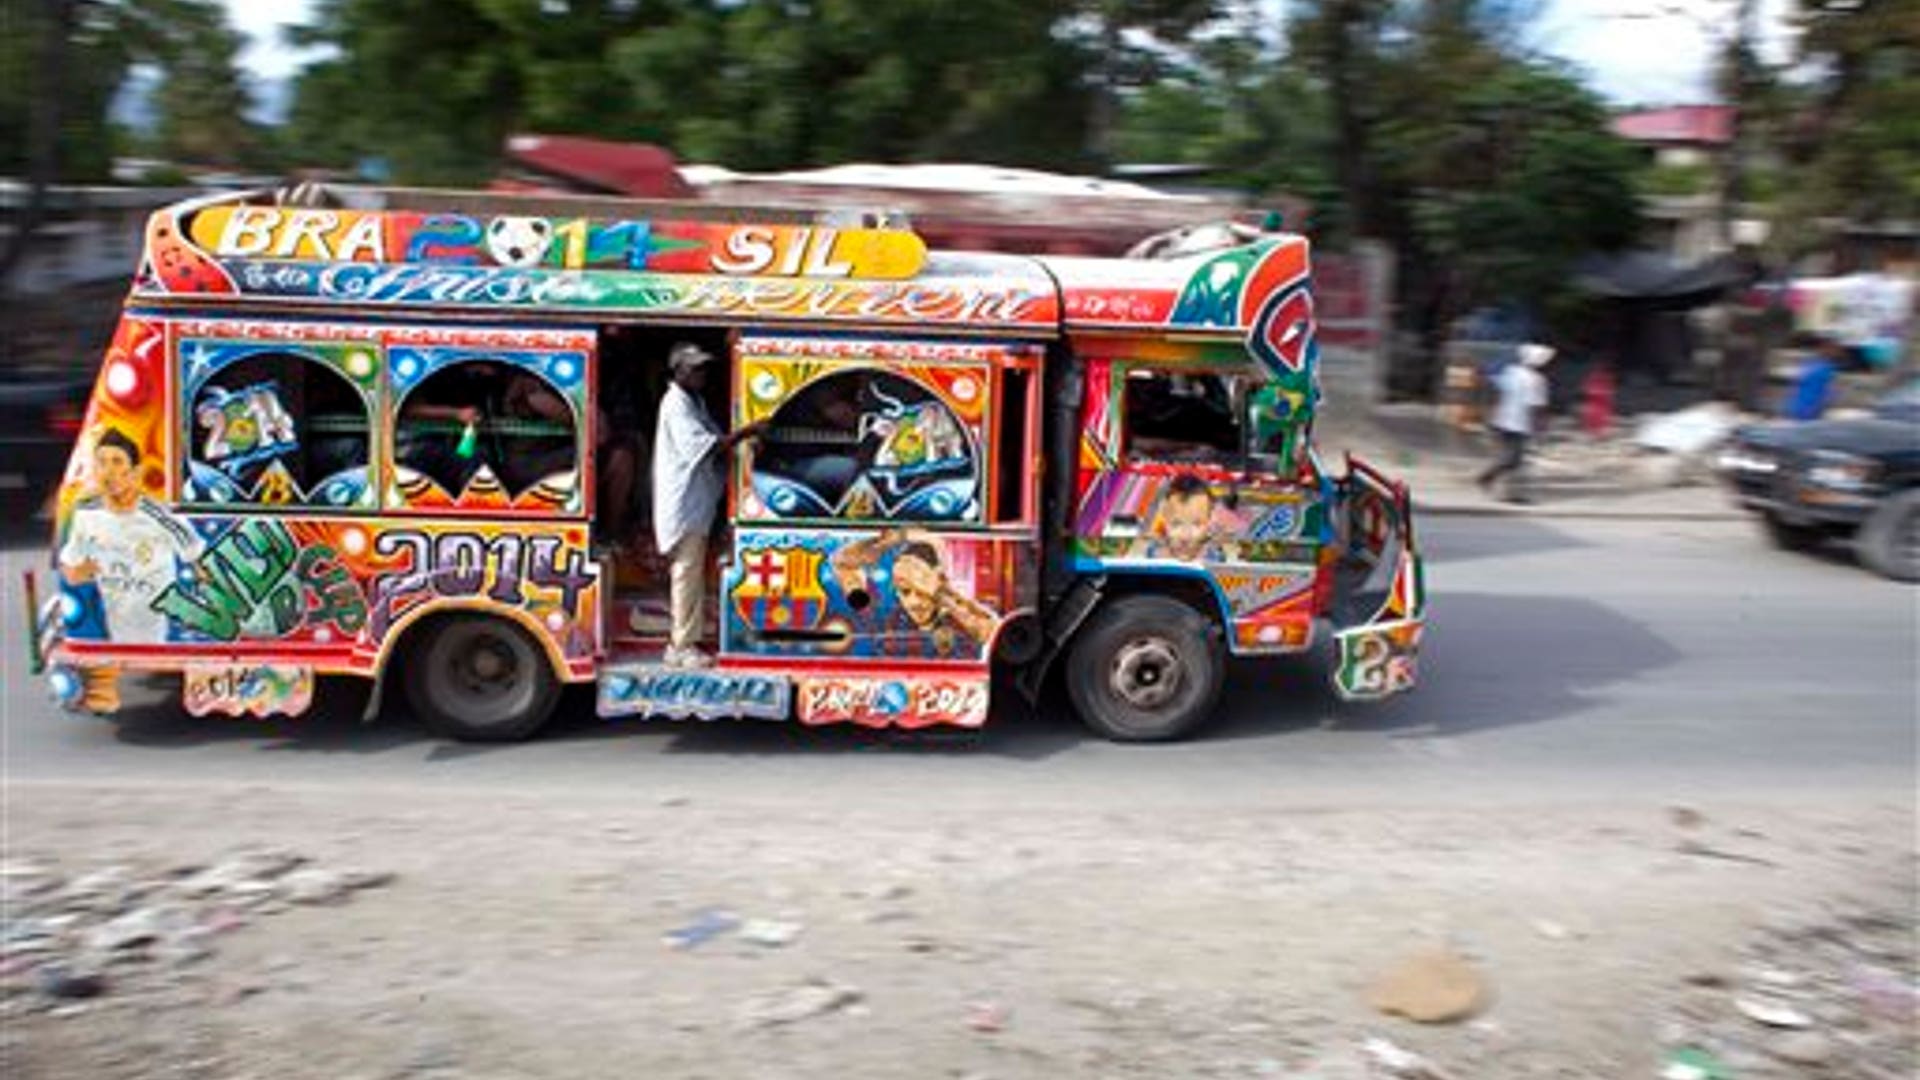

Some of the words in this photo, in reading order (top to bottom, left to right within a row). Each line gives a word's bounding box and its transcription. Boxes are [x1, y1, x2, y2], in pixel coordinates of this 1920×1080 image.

[218, 204, 386, 262] BRA
[711, 227, 852, 277] SIL
[370, 527, 598, 645] 2014
